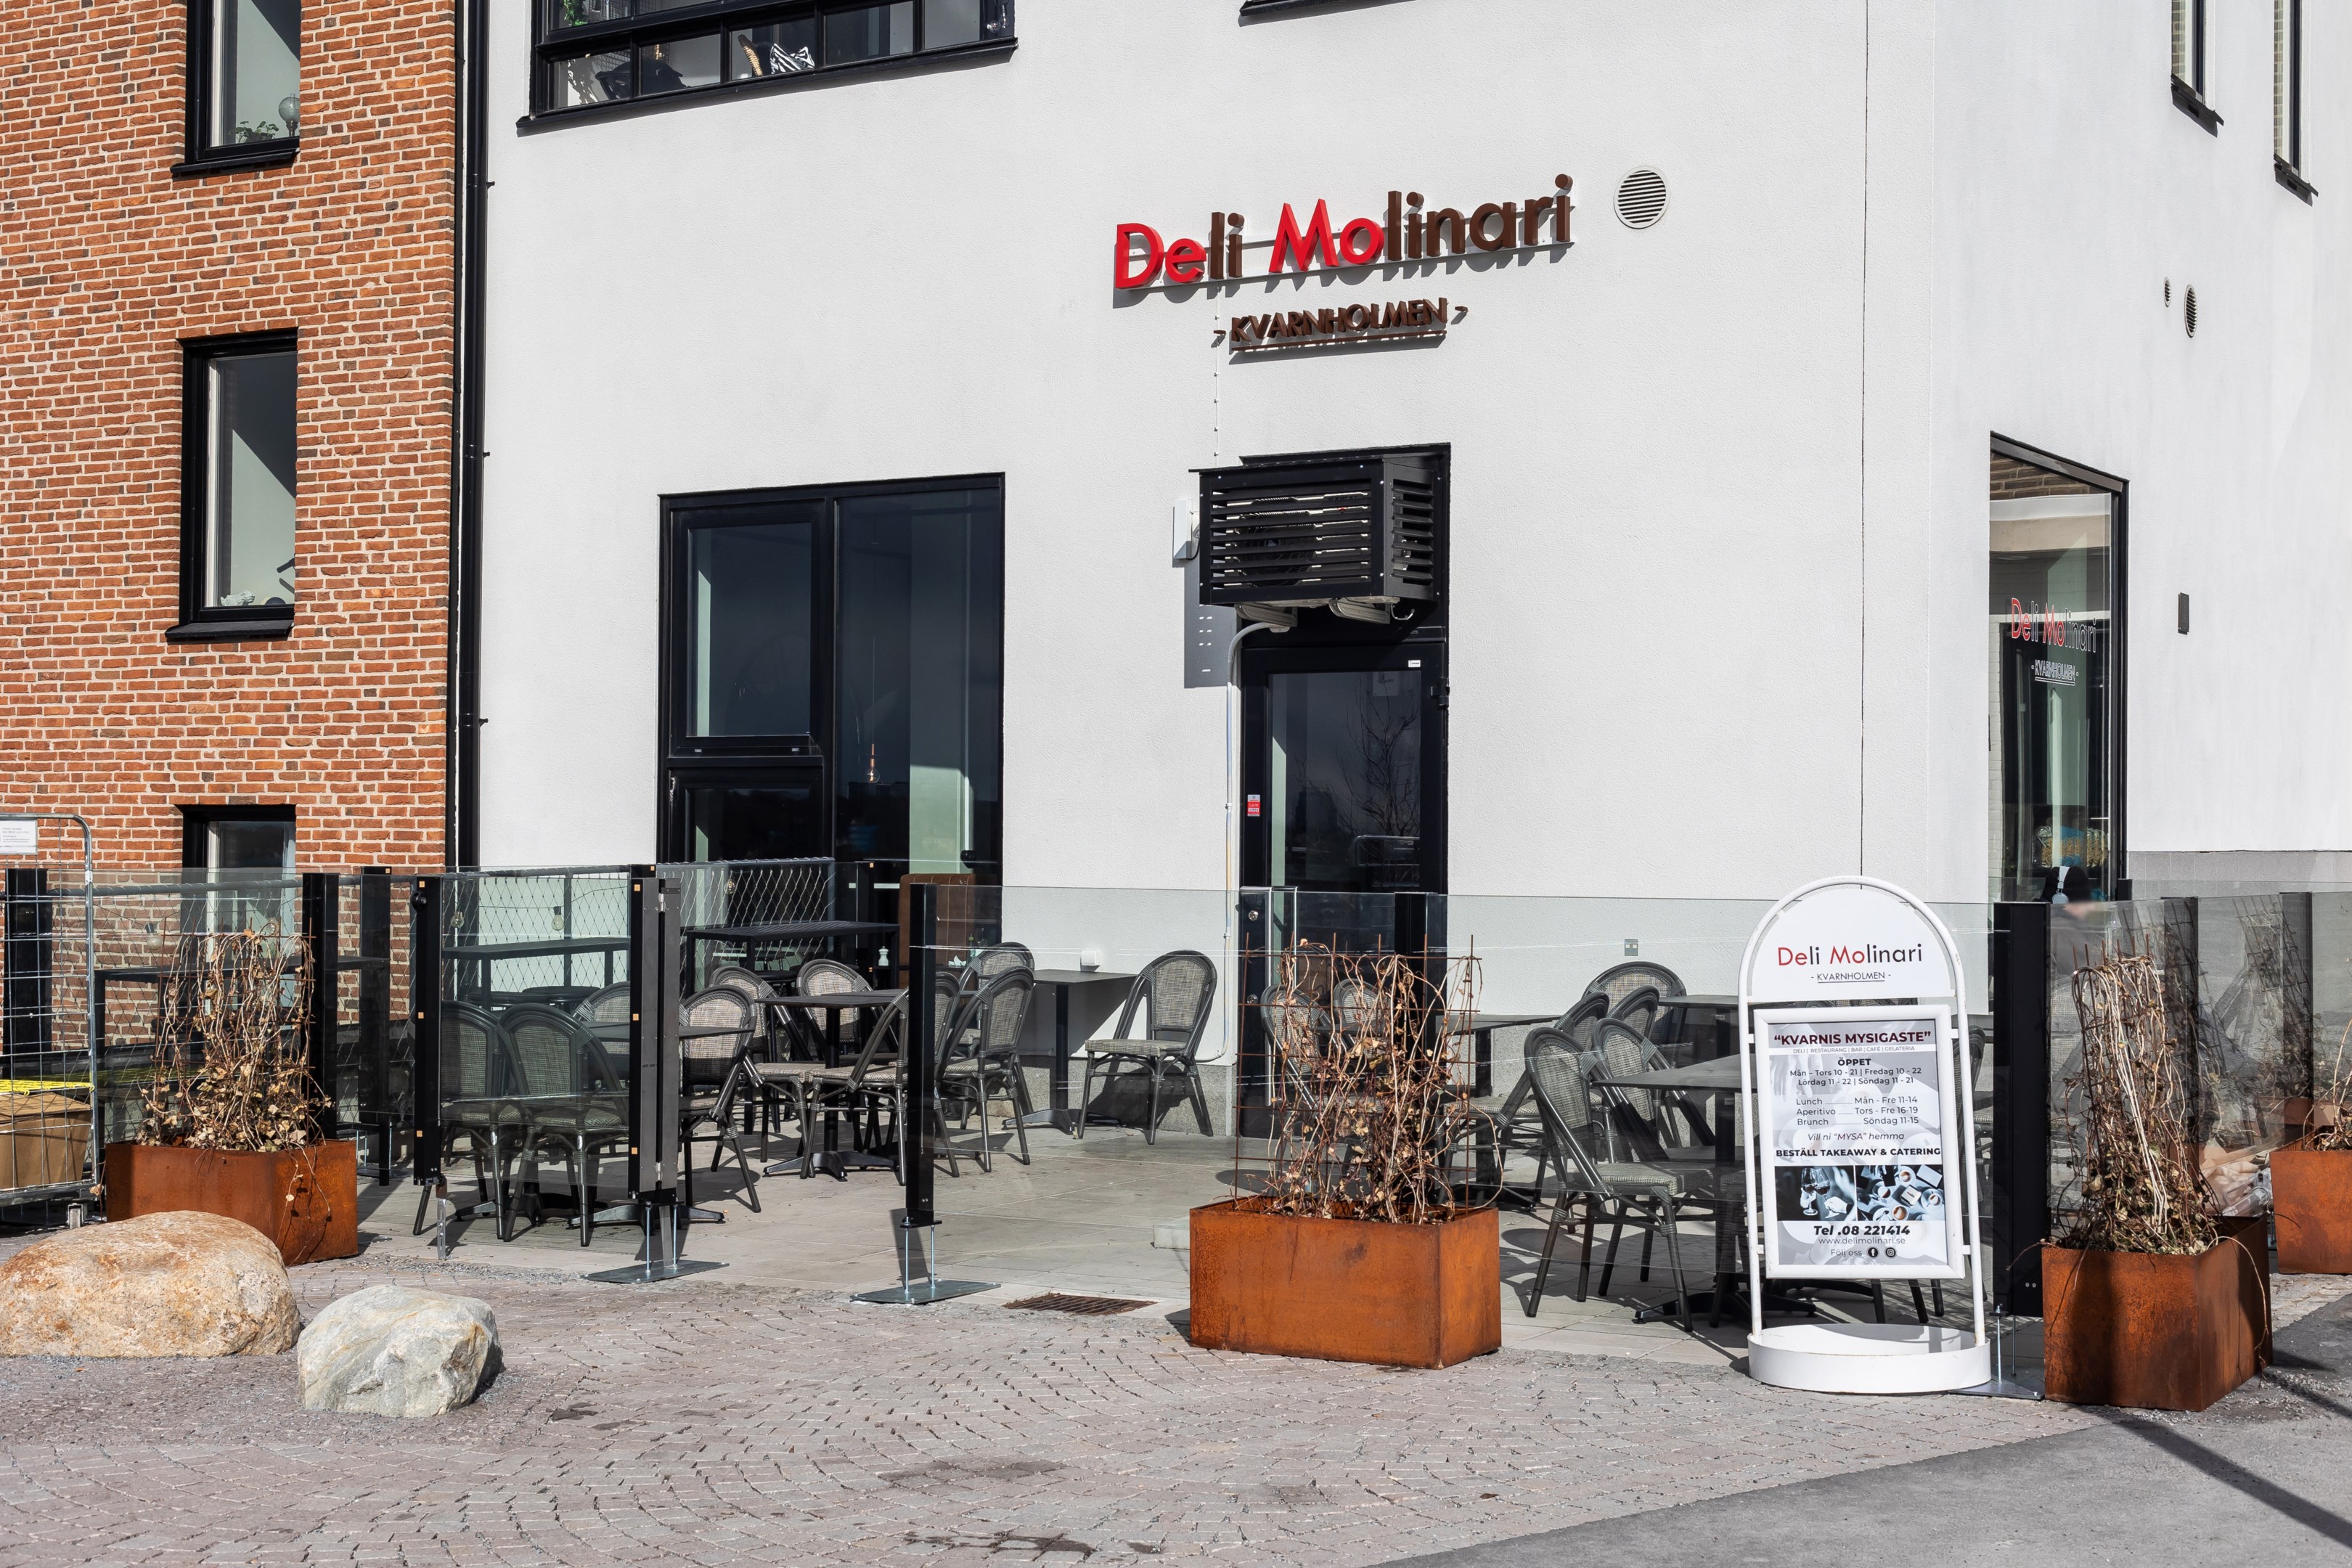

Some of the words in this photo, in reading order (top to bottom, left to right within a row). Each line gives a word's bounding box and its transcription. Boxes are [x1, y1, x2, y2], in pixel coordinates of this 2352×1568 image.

[1115, 211, 1244, 289] Deli
[1268, 173, 1573, 273] Molinari
[1230, 298, 1448, 342] KVARNHOLMEN
[2012, 597, 2038, 642] Deli
[2043, 603, 2096, 653] Molinari
[2035, 659, 2075, 681] KVARNHOLMEN
[1778, 946, 1820, 966] Deli
[1829, 943, 1922, 964] Molinari
[1817, 972, 1885, 981] KVARNHOLMEN
[1837, 1057, 1871, 1066] ÖPPET
[1858, 1077, 1890, 1085] Söndag
[1855, 1095, 1874, 1104] Mån
[1796, 1108, 1836, 1117] Aperitivo
[1863, 1116, 1898, 1126] Söndag
[1776, 1148, 1818, 1156] BESTÄLL
[1813, 1225, 1834, 1235] Tel
[1863, 1225, 1911, 1235] 221414
[1831, 1248, 1846, 1257] Följ
